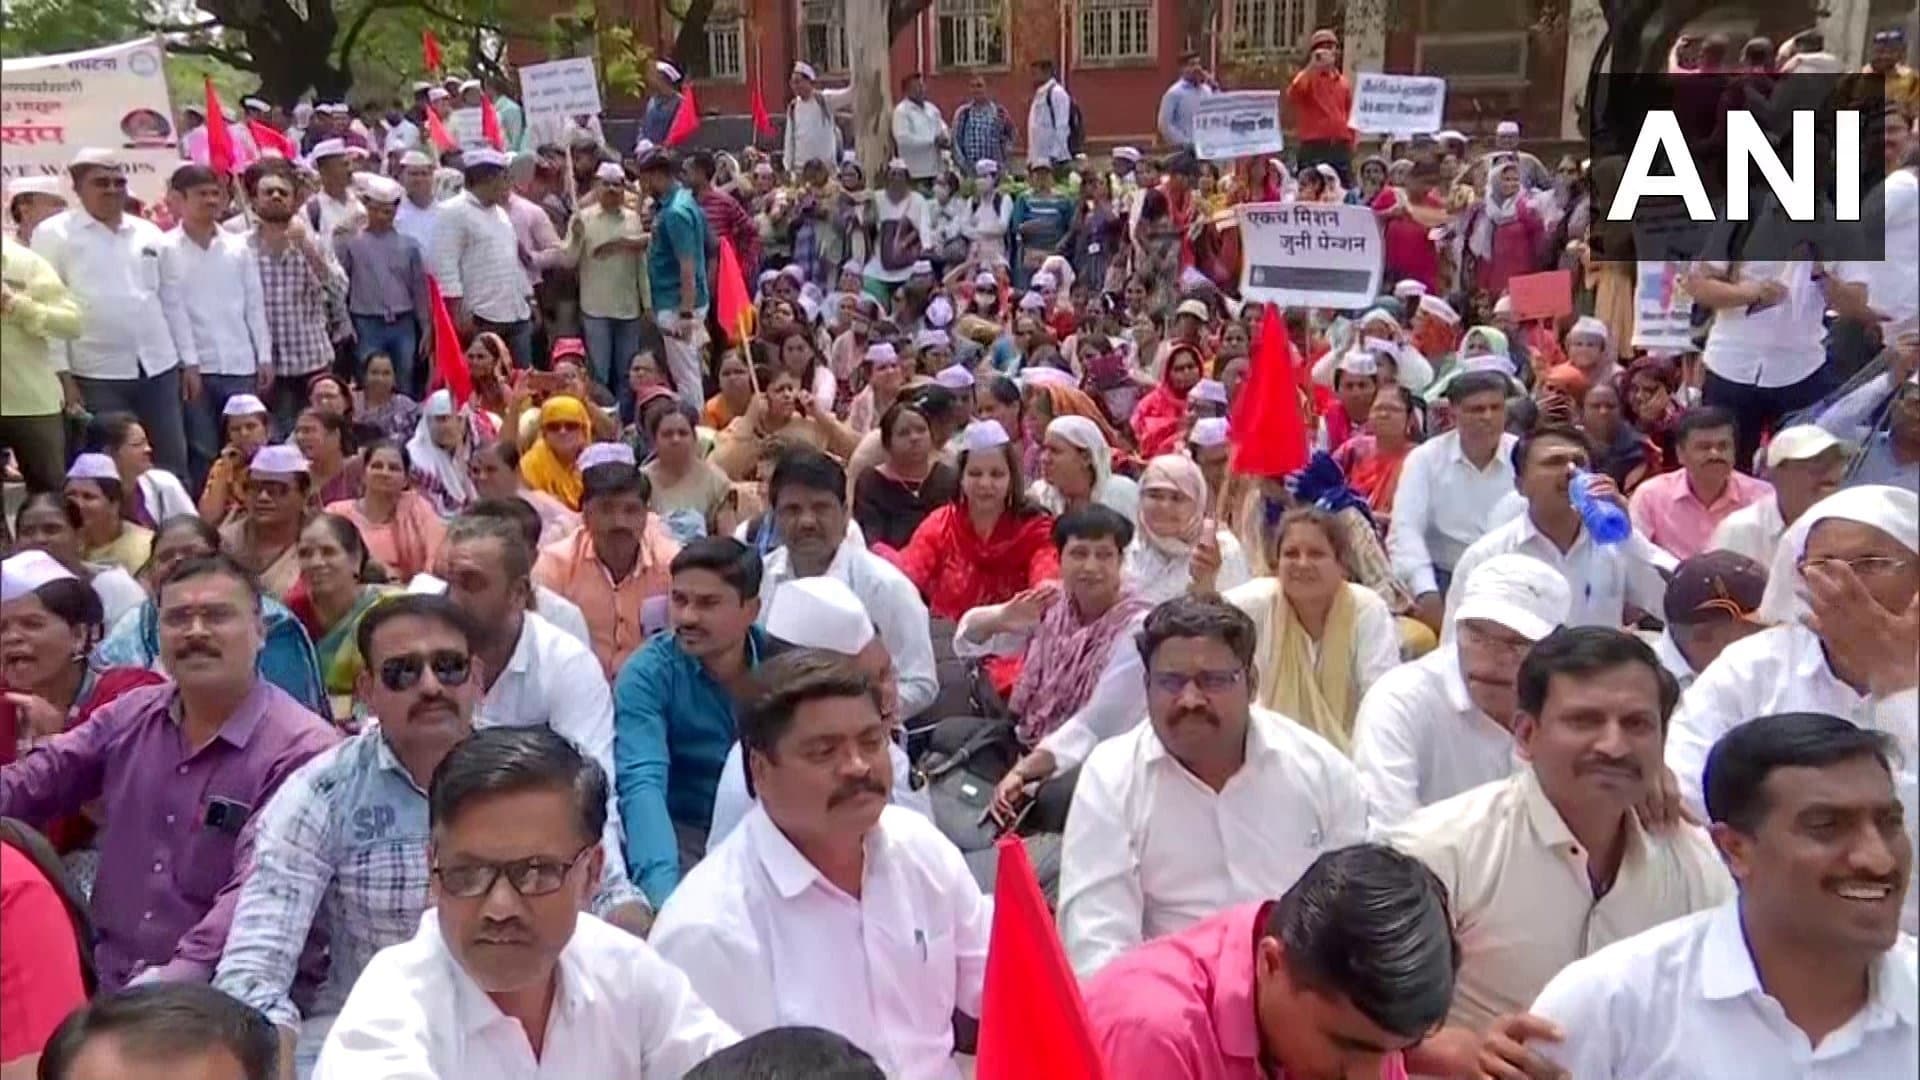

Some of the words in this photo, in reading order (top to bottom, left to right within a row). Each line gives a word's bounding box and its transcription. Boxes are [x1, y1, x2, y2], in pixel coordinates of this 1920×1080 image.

[1247, 210, 1288, 228] एकच
[1293, 205, 1340, 227] मिशन
[1280, 231, 1311, 256] जुनी
[1317, 231, 1366, 252] पेन्शन
[352, 804, 396, 840] SP
